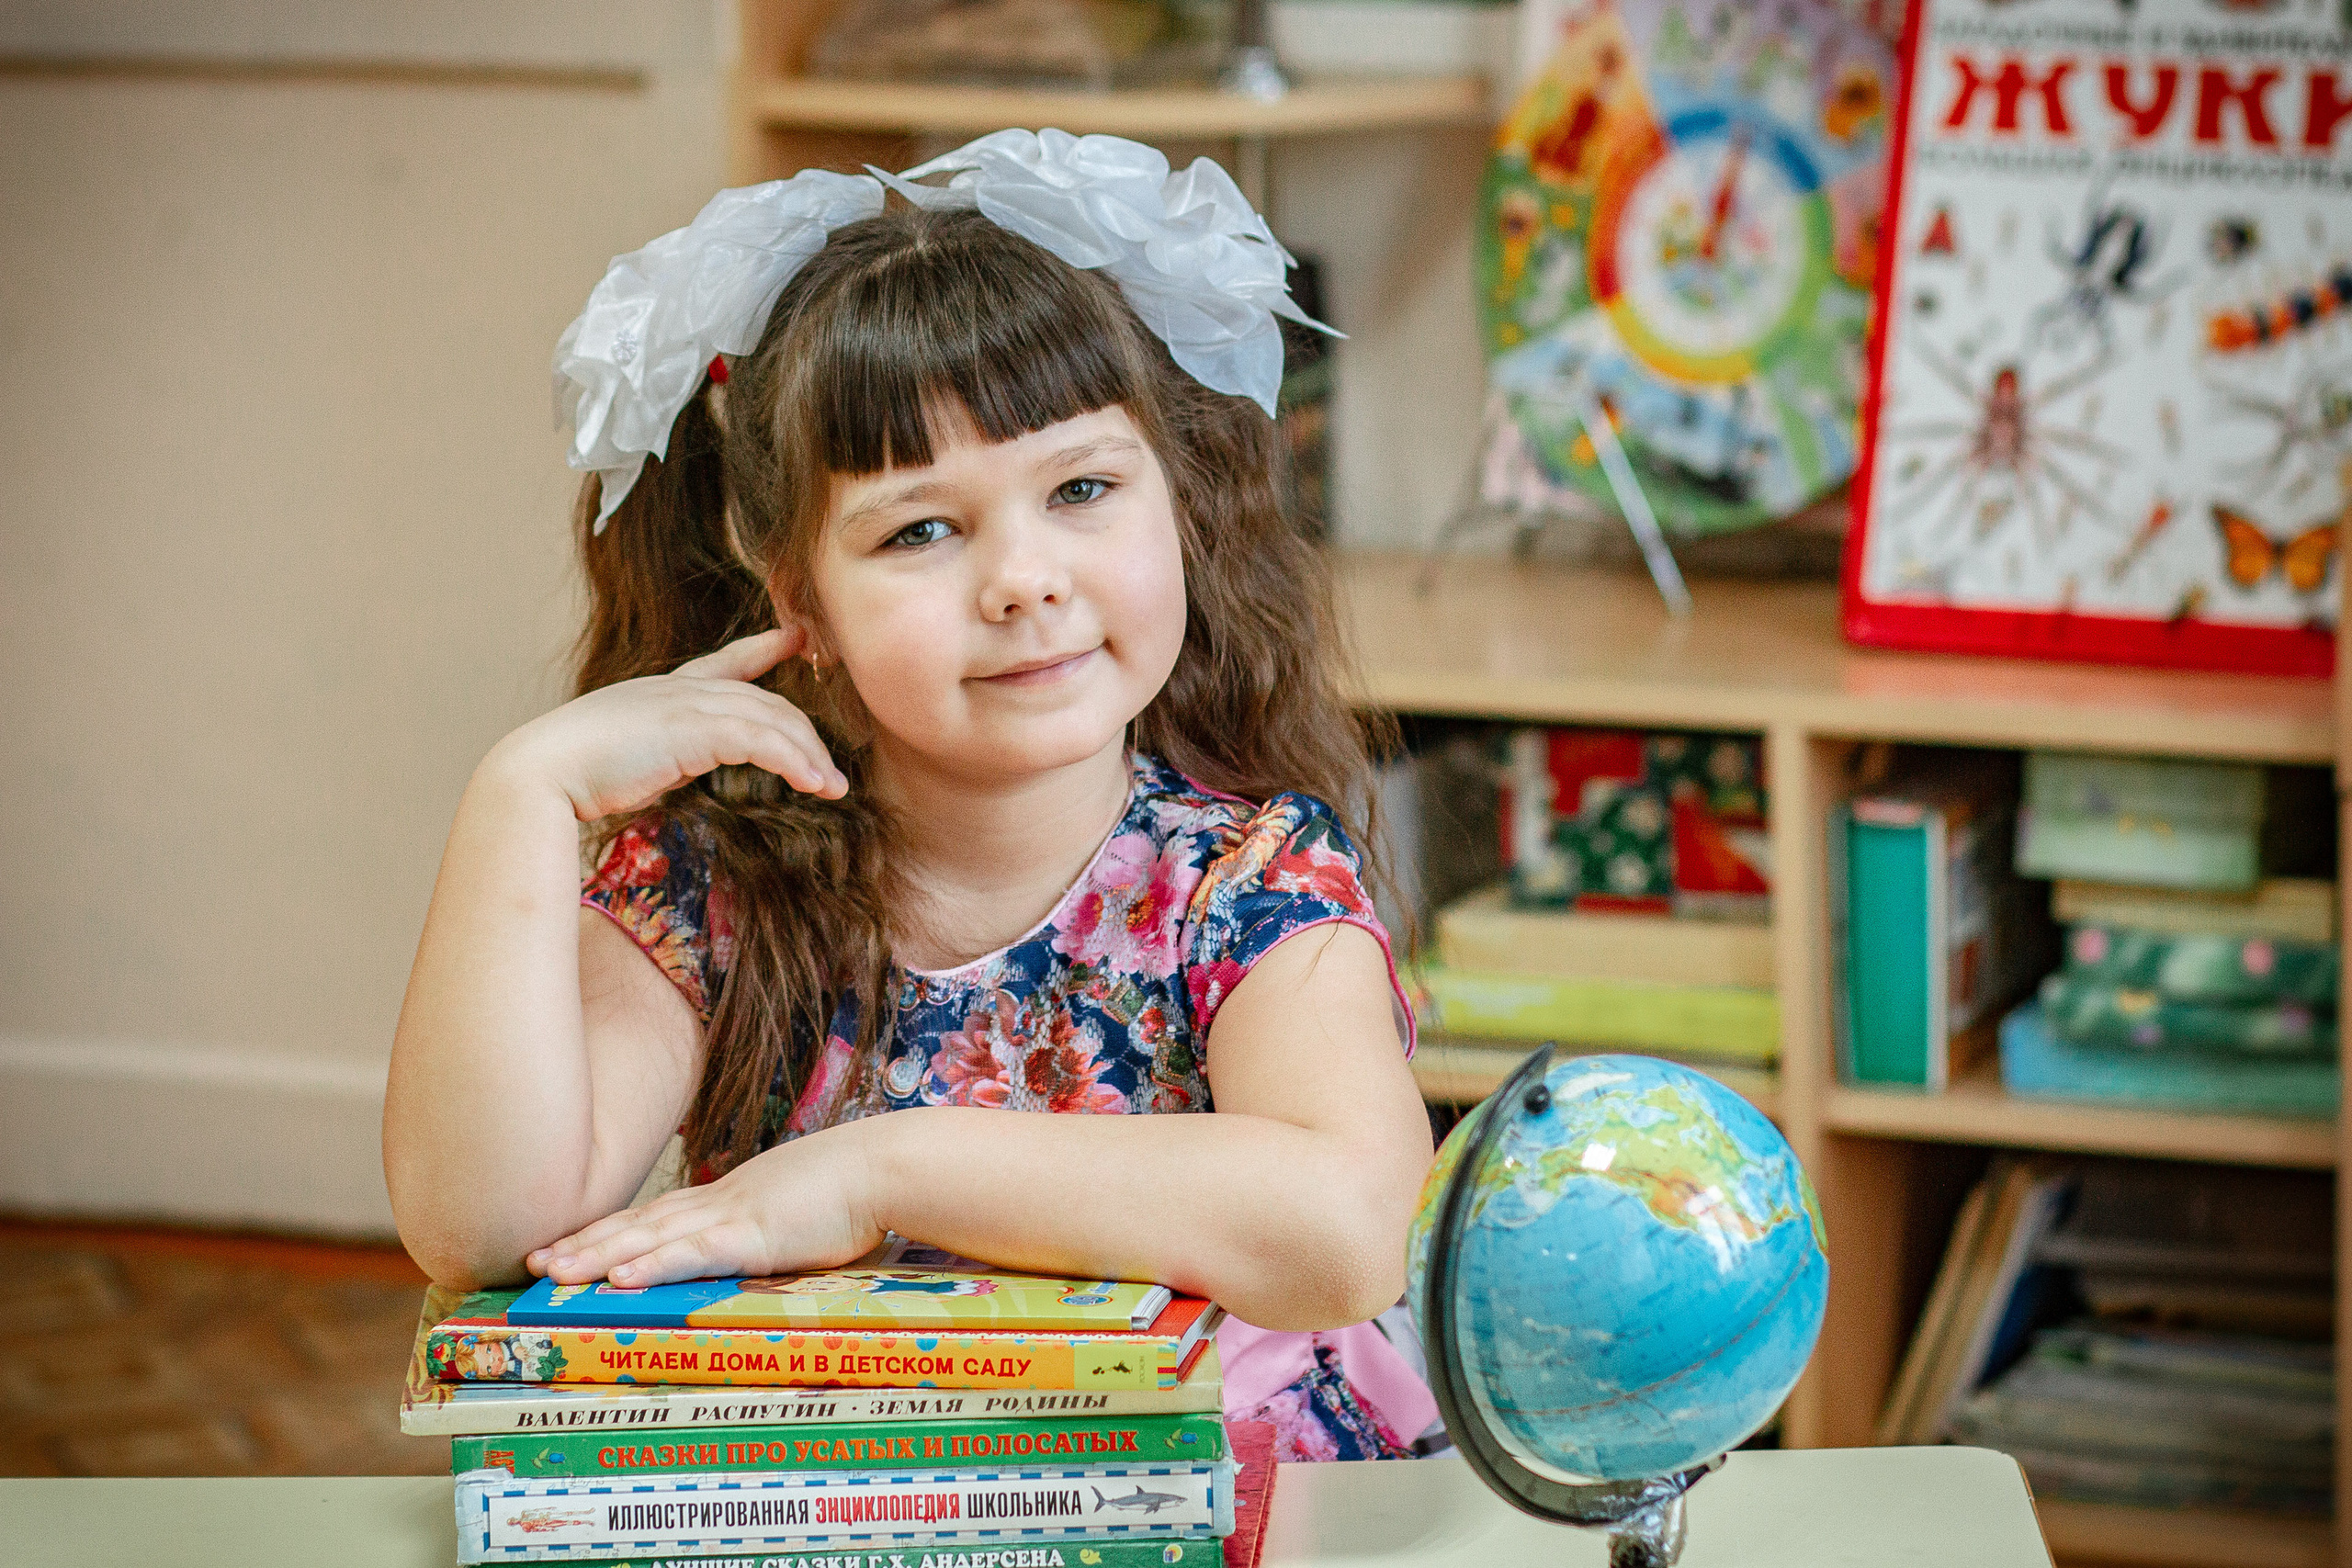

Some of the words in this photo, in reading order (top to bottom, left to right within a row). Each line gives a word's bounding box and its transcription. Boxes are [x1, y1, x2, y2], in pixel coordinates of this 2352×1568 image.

[599, 1350, 699, 1371] ЧИТАЕМ
[707, 1352, 781, 1372] ДОМА
[789, 1354, 806, 1372] И
[814, 1355, 830, 1372] В
[838, 1355, 955, 1375] ДЕТСКОМ
[962, 1358, 1032, 1378] САДУ
[514, 1407, 673, 1427] ВАЛЕНТИН
[688, 1403, 840, 1422] РАСПУТИН
[869, 1398, 965, 1416] ЗЕМЛЯ
[984, 1394, 1110, 1415] РОДИНЫ
[597, 1443, 719, 1469] СКАЗКИ
[725, 1441, 787, 1465] ПРО
[793, 1437, 916, 1462] УСАТЫХ
[922, 1436, 944, 1459] И
[950, 1430, 1139, 1457] ПОЛОСАТЫХ
[607, 1498, 809, 1532] ИЛЛЮСТРИРОВАННАЯ
[815, 1493, 960, 1527] ЭНЦИКЛОПЕДИЯ
[967, 1489, 1083, 1519] ШКОЛЬНИКА
[919, 1549, 1067, 1568] АНДЕРСЕНА
